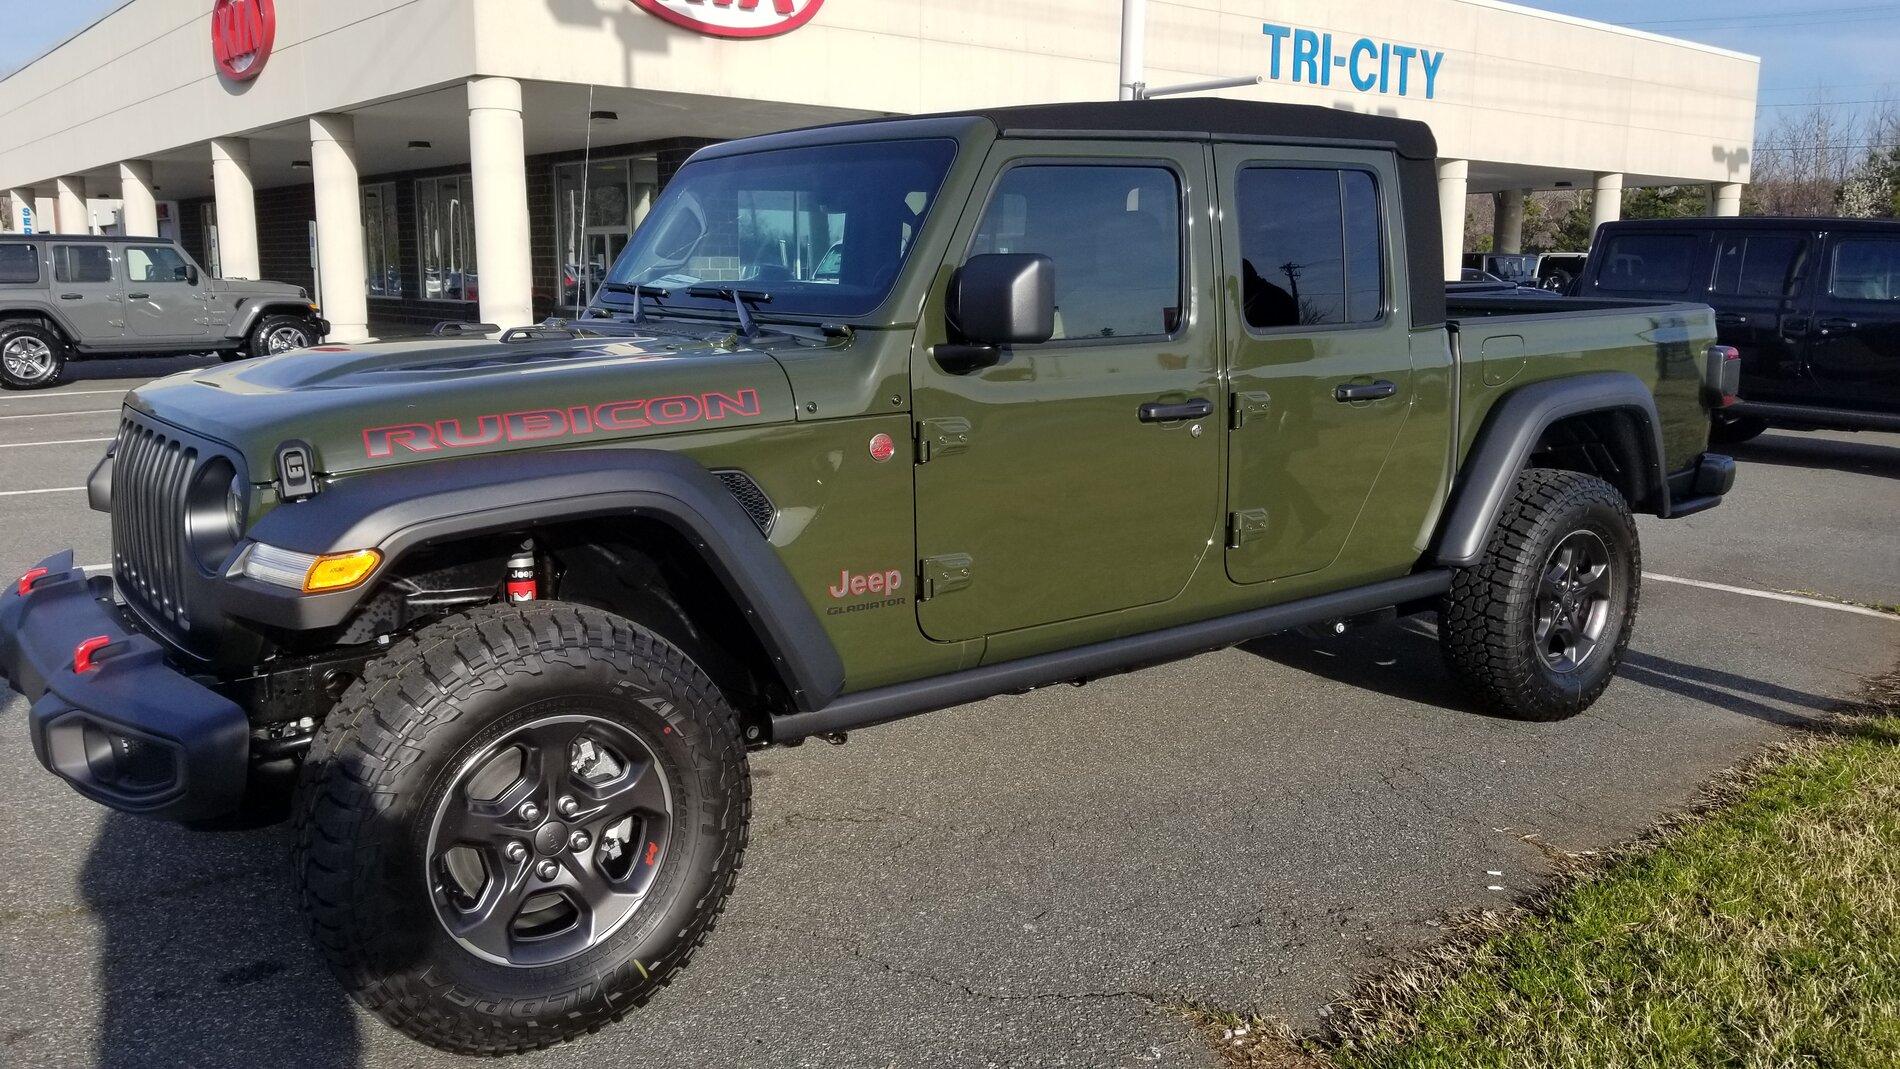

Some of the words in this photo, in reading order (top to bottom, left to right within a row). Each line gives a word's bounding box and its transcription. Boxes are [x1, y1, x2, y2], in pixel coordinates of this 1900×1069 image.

[1263, 23, 1444, 99] TRI-CITY
[362, 389, 761, 458] RUBICON
[511, 569, 534, 579] Jeep
[828, 568, 902, 598] Jeep
[826, 597, 906, 616] GLADIATOR
